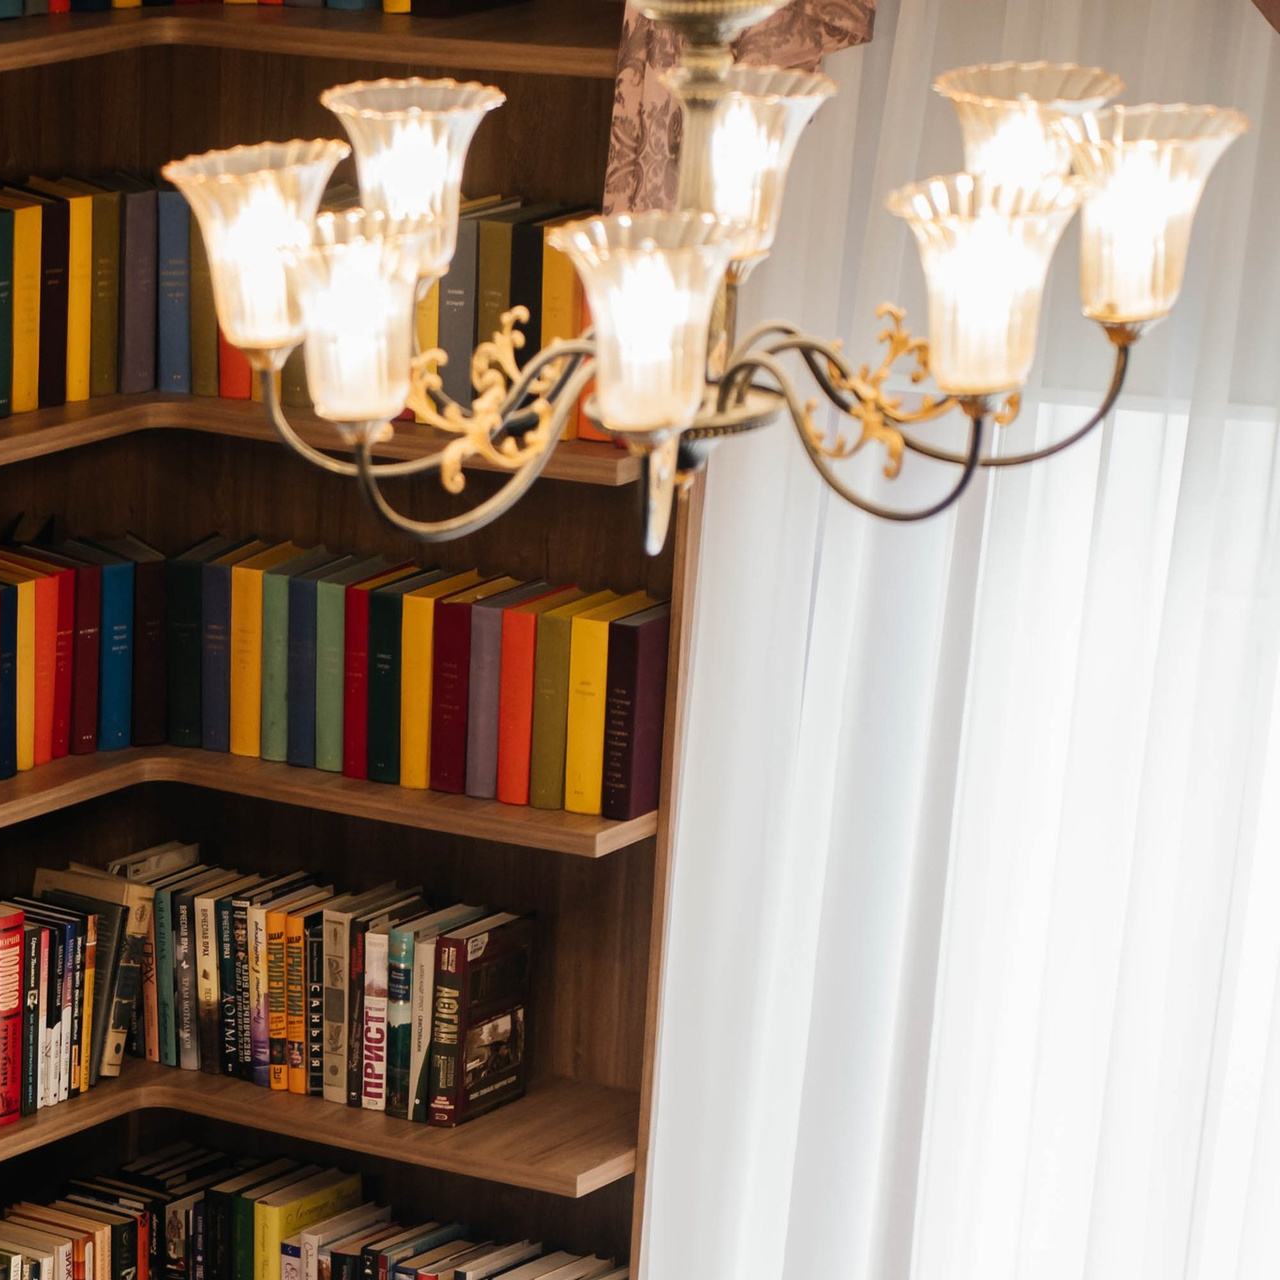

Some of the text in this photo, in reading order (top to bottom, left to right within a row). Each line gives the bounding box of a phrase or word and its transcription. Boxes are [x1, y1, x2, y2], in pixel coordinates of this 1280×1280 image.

[0, 934, 20, 947] ЮРИЙ
[268, 942, 284, 1014] ПРИЛЕПИН
[287, 945, 303, 1017] ПРИЛЕПИН
[223, 991, 236, 1054] ДОГМА
[311, 985, 320, 1067] САНЬКЯ
[364, 1009, 386, 1100] ПРИСТ
